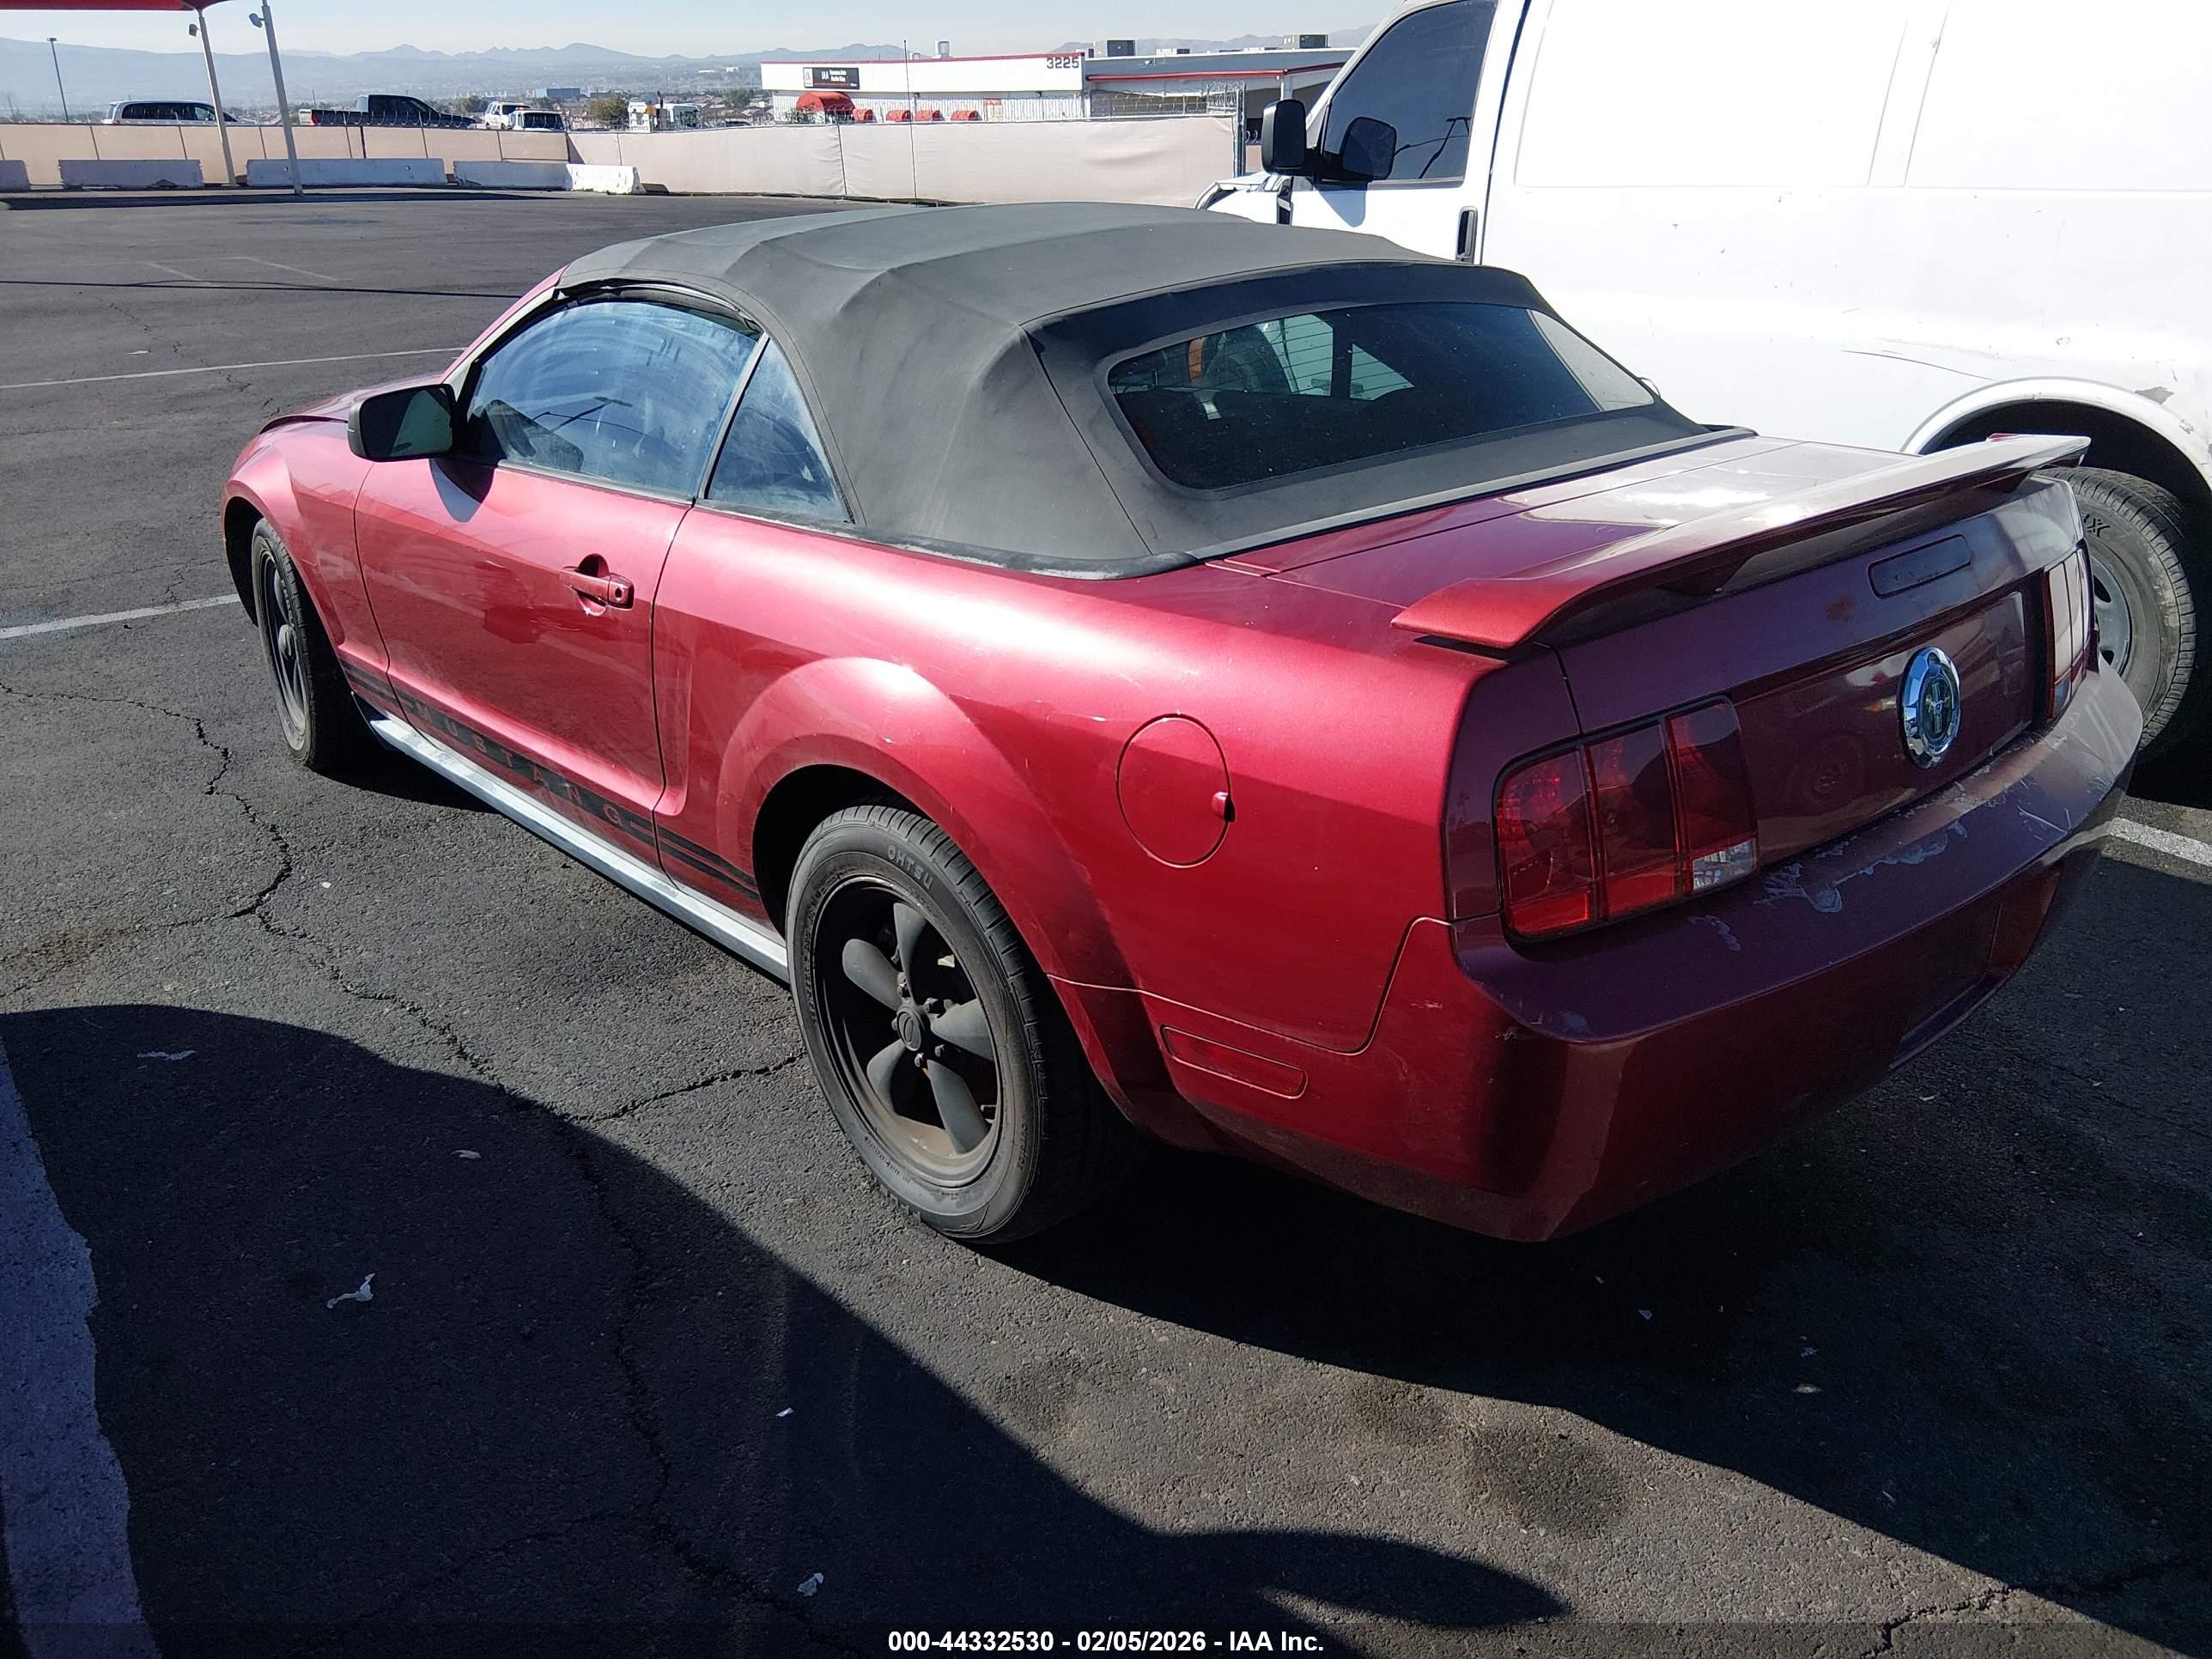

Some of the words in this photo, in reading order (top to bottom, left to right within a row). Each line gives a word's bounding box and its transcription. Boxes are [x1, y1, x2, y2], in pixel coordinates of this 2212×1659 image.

[1046, 57, 1079, 69] 3225
[418, 705, 623, 828] MUSTANG
[887, 845, 933, 890] OHTSU
